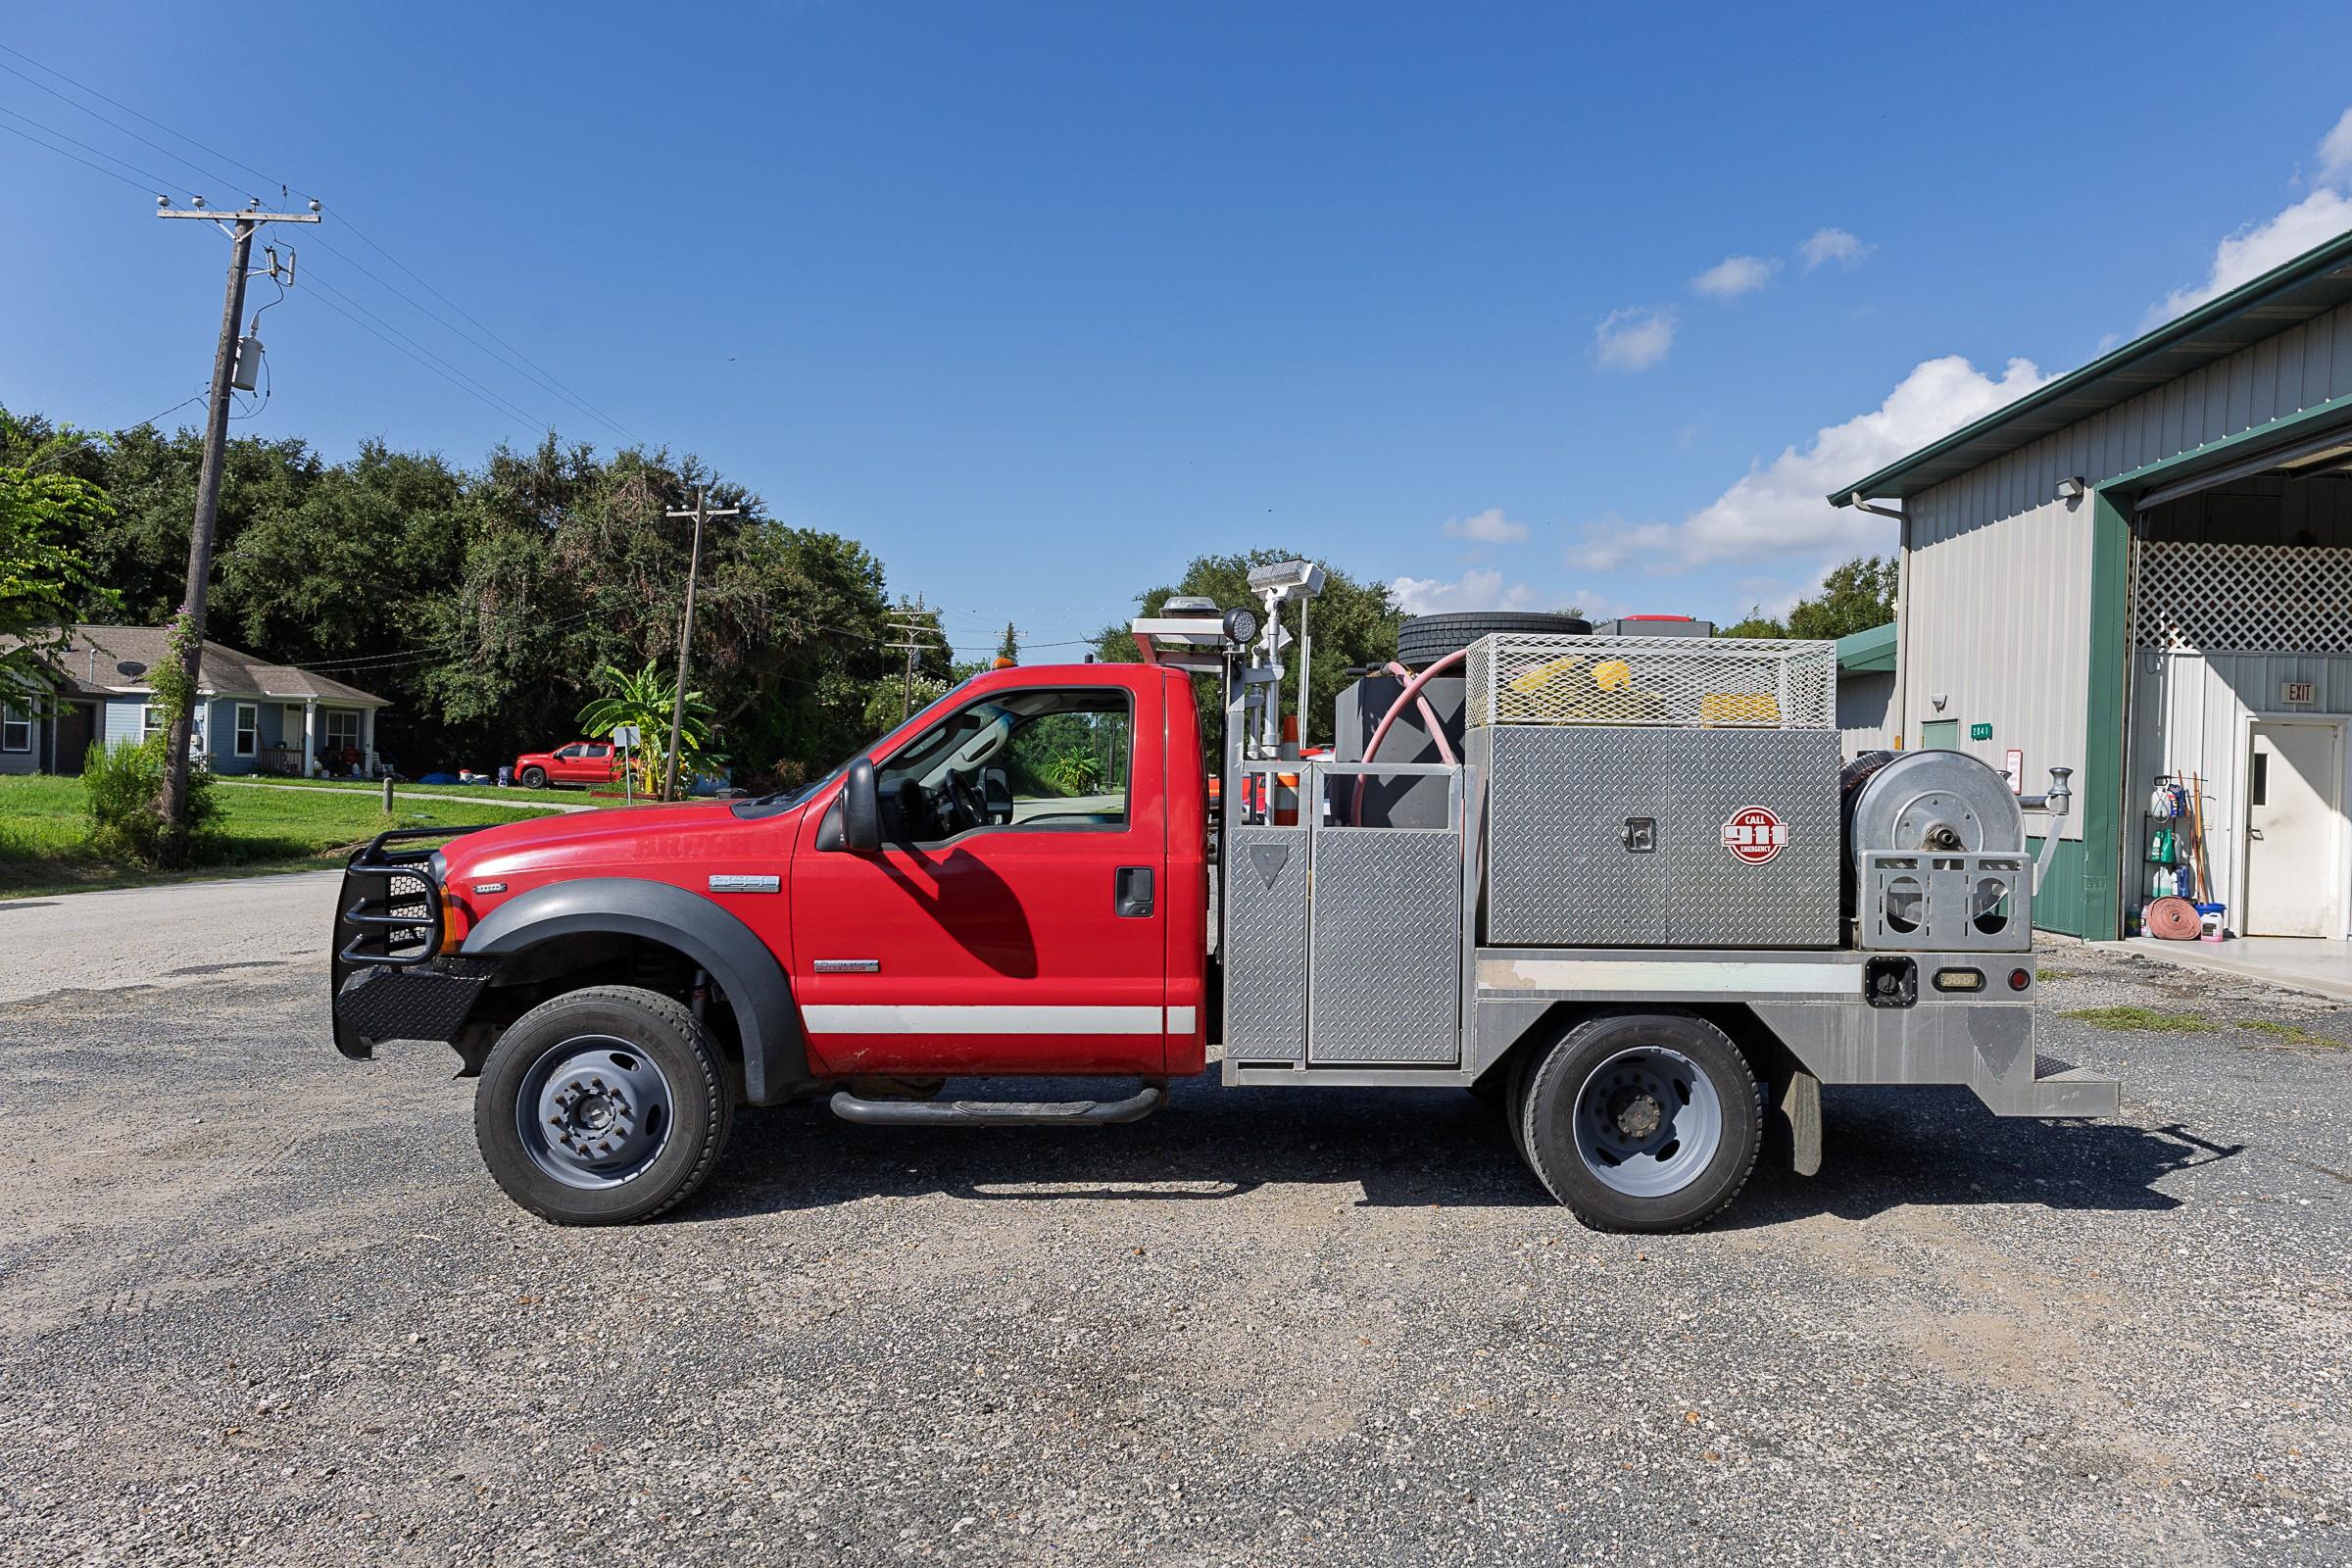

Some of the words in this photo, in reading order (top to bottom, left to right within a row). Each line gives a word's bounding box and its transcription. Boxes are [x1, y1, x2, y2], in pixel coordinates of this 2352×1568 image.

[2289, 683, 2311, 702] EXIT
[1972, 726, 1988, 736] 2041
[1744, 815, 1766, 824] CALL
[1740, 845, 1771, 854] EMERGENCY
